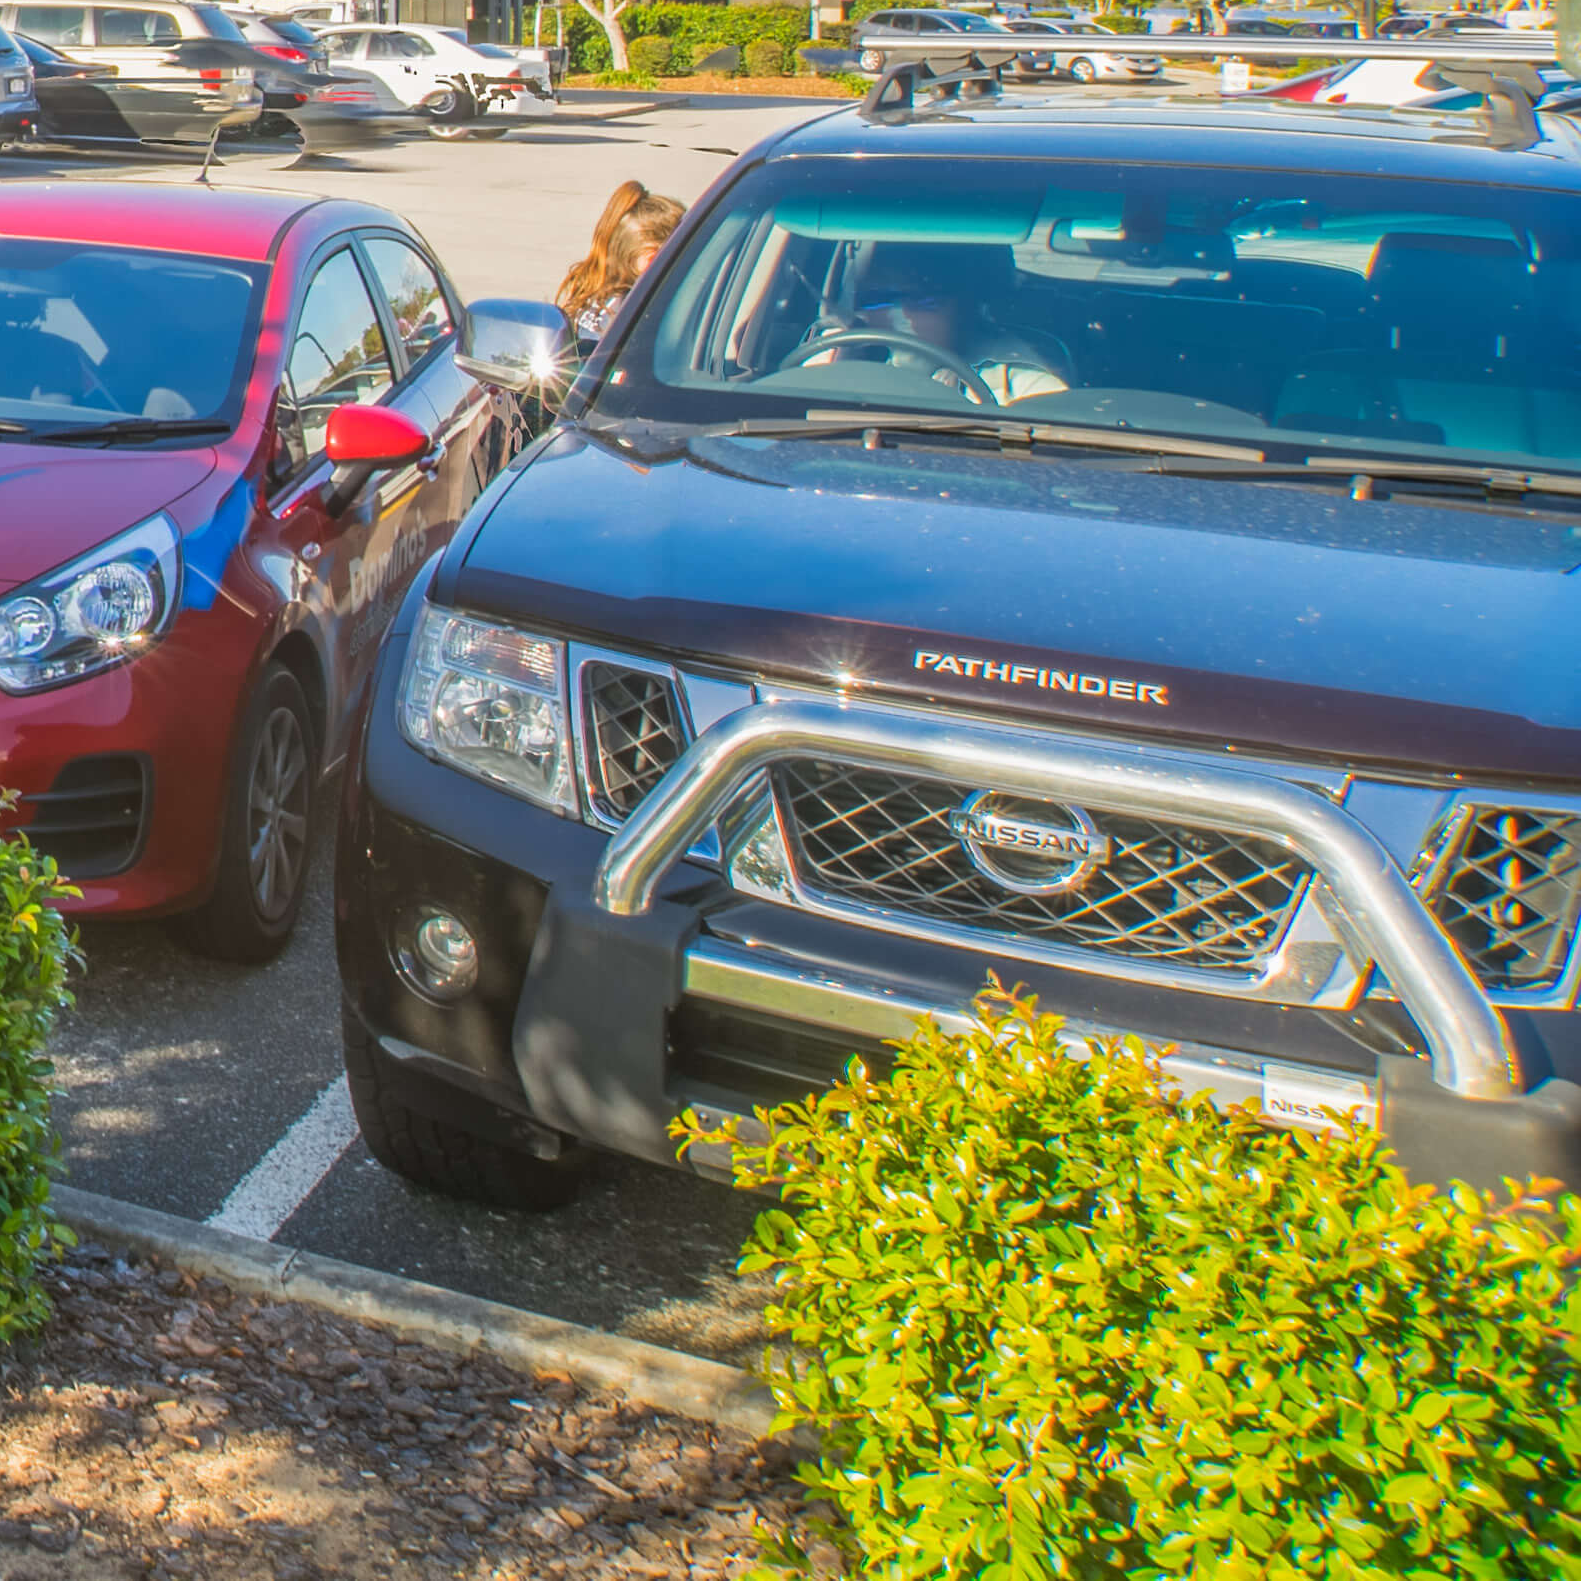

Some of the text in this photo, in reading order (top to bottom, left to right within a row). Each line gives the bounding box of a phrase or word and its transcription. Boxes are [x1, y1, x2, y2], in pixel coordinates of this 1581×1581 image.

[914, 650, 1170, 706] PATHFINDER
[964, 818, 1090, 855] NISSAN
[1269, 1098, 1326, 1120] NISS
